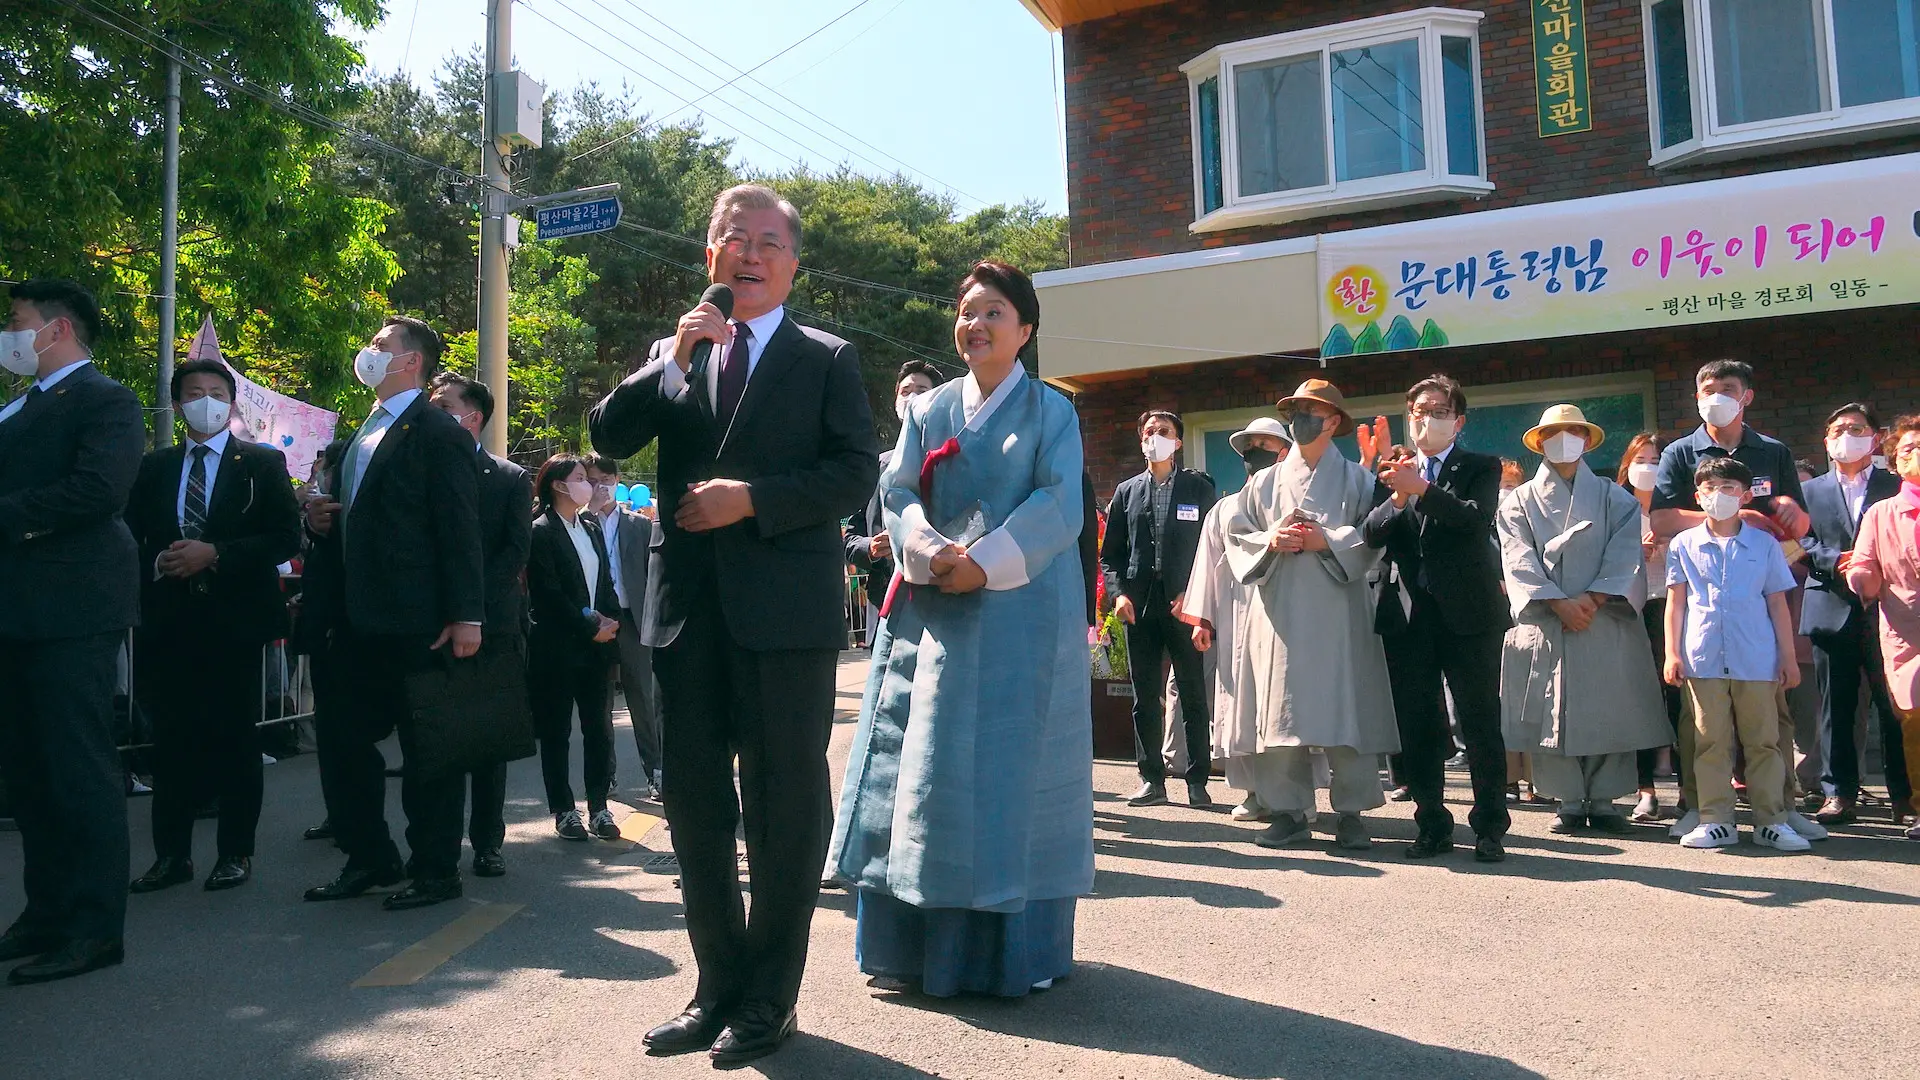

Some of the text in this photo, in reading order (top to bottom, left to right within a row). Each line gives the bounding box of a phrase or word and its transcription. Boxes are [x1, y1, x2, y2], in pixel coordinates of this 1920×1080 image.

[540, 204, 599, 226] 평산마을2길
[540, 218, 611, 237] Pyeongsanmaeul 2-gil
[1394, 238, 1608, 310] 문대통령님
[1631, 224, 1768, 279] 이웃이
[1786, 215, 1885, 263] 되어
[1335, 278, 1376, 314] 환
[1662, 278, 1871, 316] 평산 마을 경로회 일동
